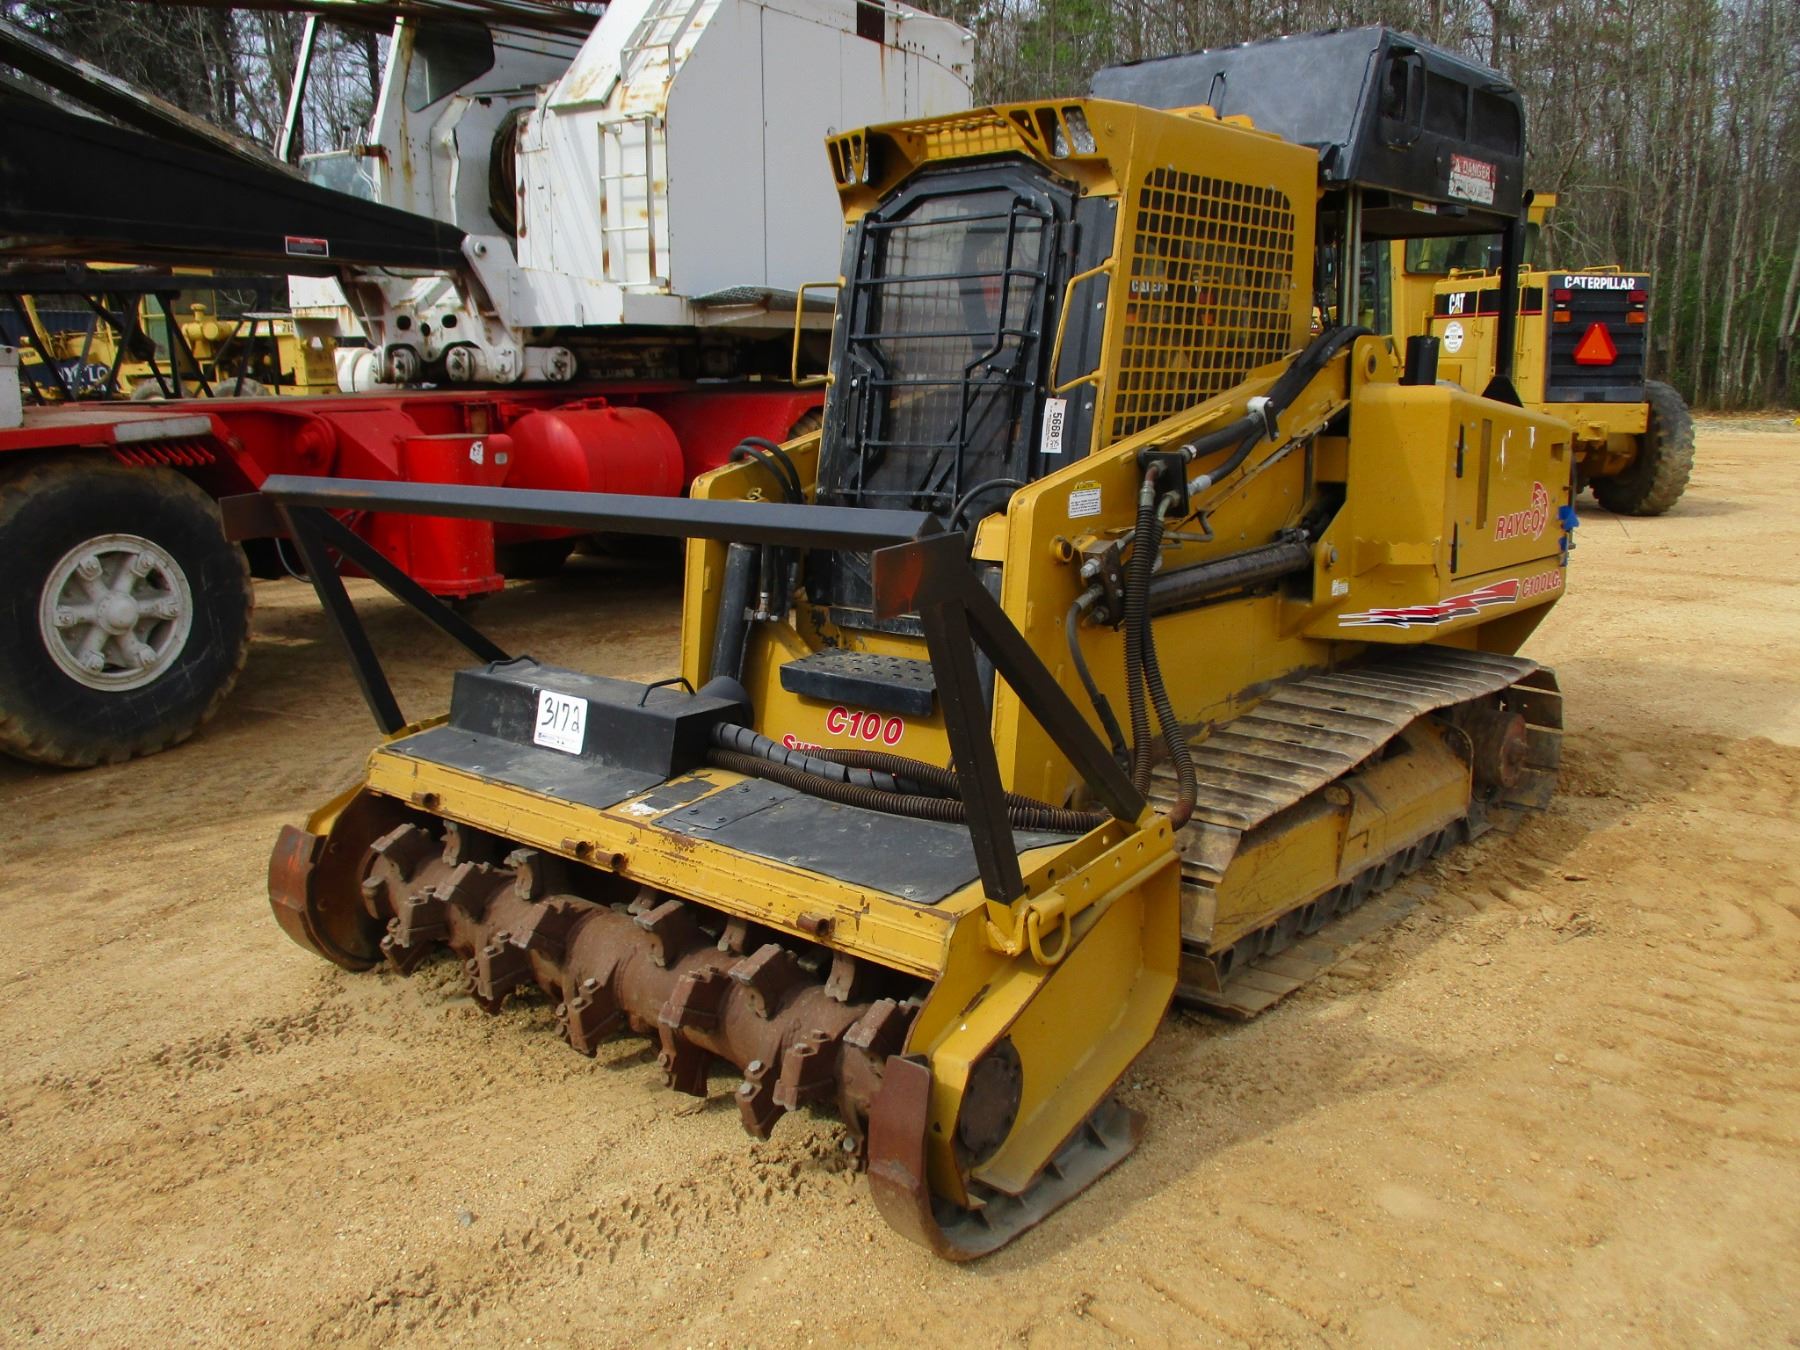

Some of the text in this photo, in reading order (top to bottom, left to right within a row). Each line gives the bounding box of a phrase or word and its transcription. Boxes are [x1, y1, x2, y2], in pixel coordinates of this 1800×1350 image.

[1564, 276, 1635, 290] CATERPILLAR
[1448, 293, 1466, 315] CAT
[1050, 411, 1063, 438] 5668
[1494, 508, 1542, 541] RAYCO
[541, 697, 580, 733] 3172
[825, 705, 905, 746] C100
